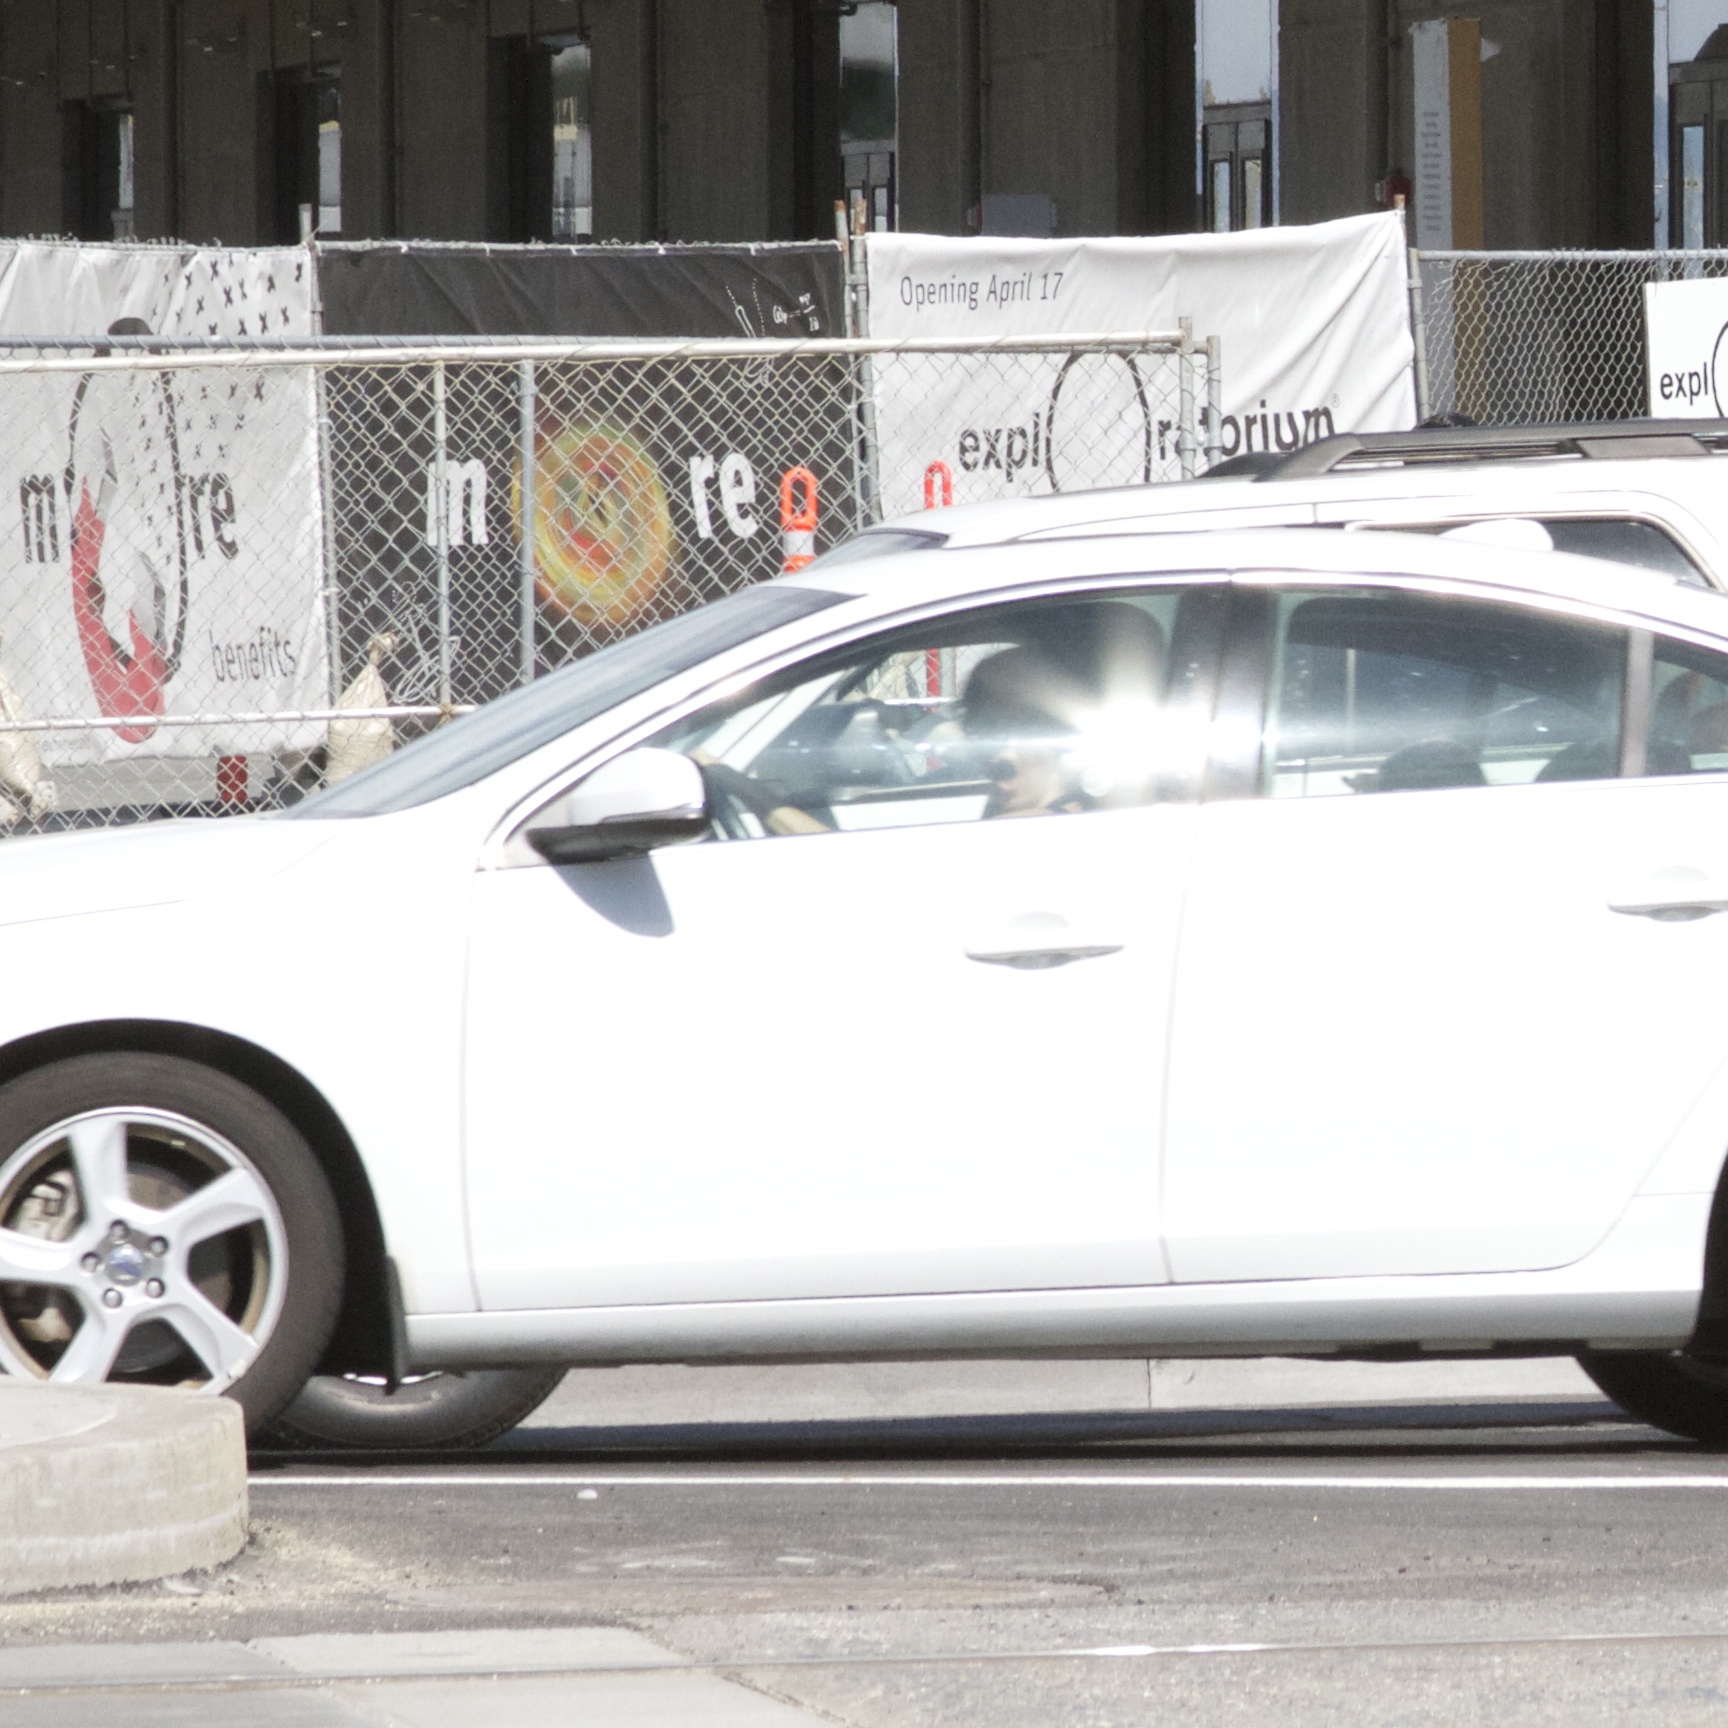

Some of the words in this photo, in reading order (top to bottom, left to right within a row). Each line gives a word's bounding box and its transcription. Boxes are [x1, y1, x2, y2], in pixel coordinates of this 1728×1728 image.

[900, 275, 980, 312] Opening
[987, 271, 1032, 310] April
[1040, 271, 1064, 301] 17
[208, 626, 297, 682] benefits
